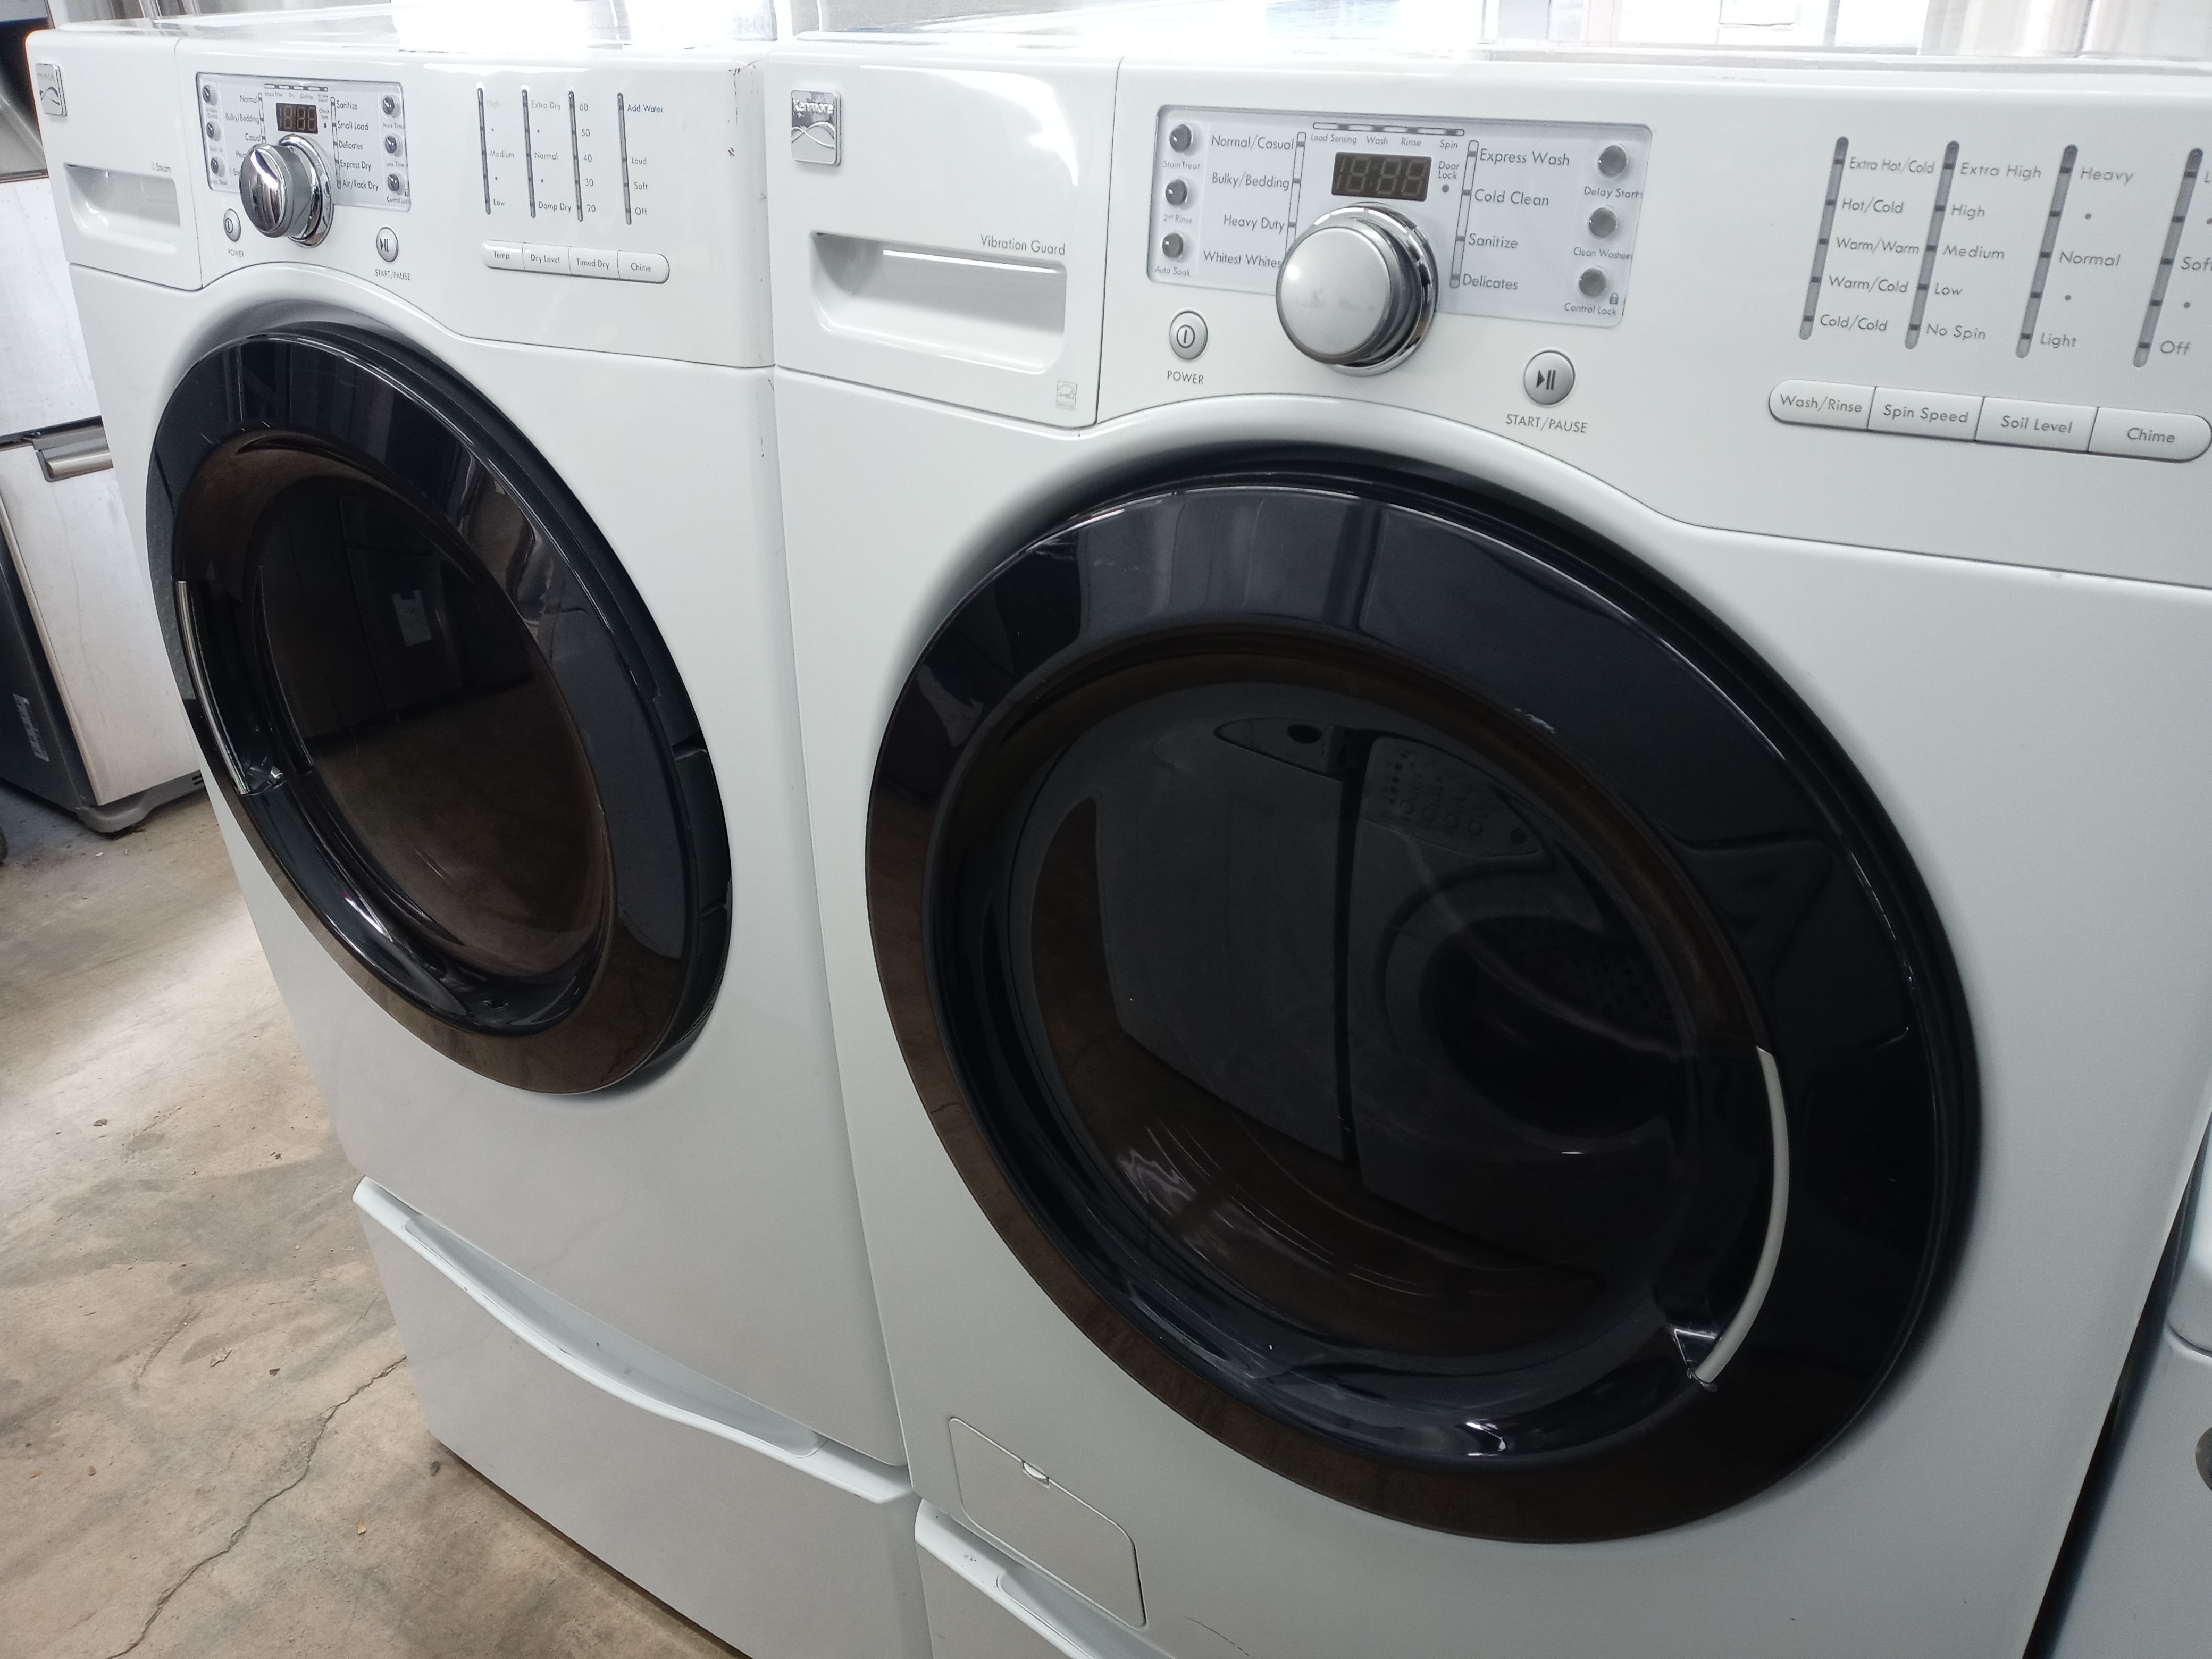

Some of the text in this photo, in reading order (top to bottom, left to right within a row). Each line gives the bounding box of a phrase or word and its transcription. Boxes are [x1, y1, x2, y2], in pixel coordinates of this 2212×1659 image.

[337, 100, 357, 110] Sanitize
[550, 102, 560, 111] Dry
[579, 103, 588, 112] 60
[627, 104, 664, 113] Add Water
[225, 113, 259, 124] Bulky/Bedding
[337, 120, 368, 130] Small Load
[245, 133, 261, 141] Casual
[1211, 135, 1294, 150] Normal/Casual
[1311, 133, 1357, 145] Load Sensing
[1367, 136, 1388, 145] Wash
[1401, 137, 1421, 146] Rinse
[339, 140, 363, 150] Delicates
[1439, 139, 1458, 149] Spin
[583, 154, 592, 163] 40
[1480, 148, 1570, 166] Express Wash
[340, 160, 371, 172] Express Dry
[1439, 161, 1459, 170] Door
[1849, 157, 1935, 174] Extra Hot/Cold
[1960, 162, 2041, 181] Extra High
[1212, 171, 1289, 191] Bulky/Bedding
[1438, 170, 1457, 179] Lock
[2080, 167, 2134, 184] Heavy
[342, 180, 379, 191] Air/Rack Dry
[585, 179, 594, 187] 30
[1474, 189, 1549, 206] Cold Clean
[1584, 187, 1640, 199] Delay Start
[539, 202, 572, 214] Damp Dry
[587, 204, 596, 213] 20
[635, 207, 647, 216] Off
[1842, 197, 1904, 214] Hot/Cold
[1951, 204, 1985, 220] High
[1175, 214, 1193, 224] Rinse
[1224, 214, 1285, 234] Heavy Duty
[981, 234, 1066, 256] Vibration Guard
[1468, 233, 1518, 249] Sanitize
[1837, 237, 1920, 254] Warm/Warm
[228, 249, 244, 258] POWER
[493, 251, 510, 261] Temp
[1573, 247, 1632, 260] Clean Washer
[1943, 245, 2005, 259] Medium
[531, 254, 560, 264] Dry Level
[576, 258, 609, 270] Timed Dry
[1203, 250, 1283, 269] Whitest Whites
[2058, 251, 2121, 267] Normal
[2181, 256, 2212, 271] Sof
[631, 263, 651, 273] Chime
[1154, 265, 1191, 276] Auto Soak
[375, 269, 410, 281] START/PAUSE
[1463, 274, 1518, 290] Delicates
[1829, 275, 1909, 293] Warm/Cold
[1934, 283, 1963, 296] Low
[1564, 302, 1617, 316] Control Lock
[1820, 314, 1888, 331] Cold/Cold
[1926, 323, 1987, 341] No Spin
[2040, 333, 2076, 348] Light
[2160, 341, 2191, 355] Off
[1167, 370, 1204, 385] POWER
[1780, 394, 1863, 414] Wash/Rinse
[1883, 404, 1970, 424] Spin Speed
[1506, 413, 1587, 433] START/PAUSE
[2000, 415, 2073, 434] Soil Level
[2127, 426, 2175, 444] Chime
